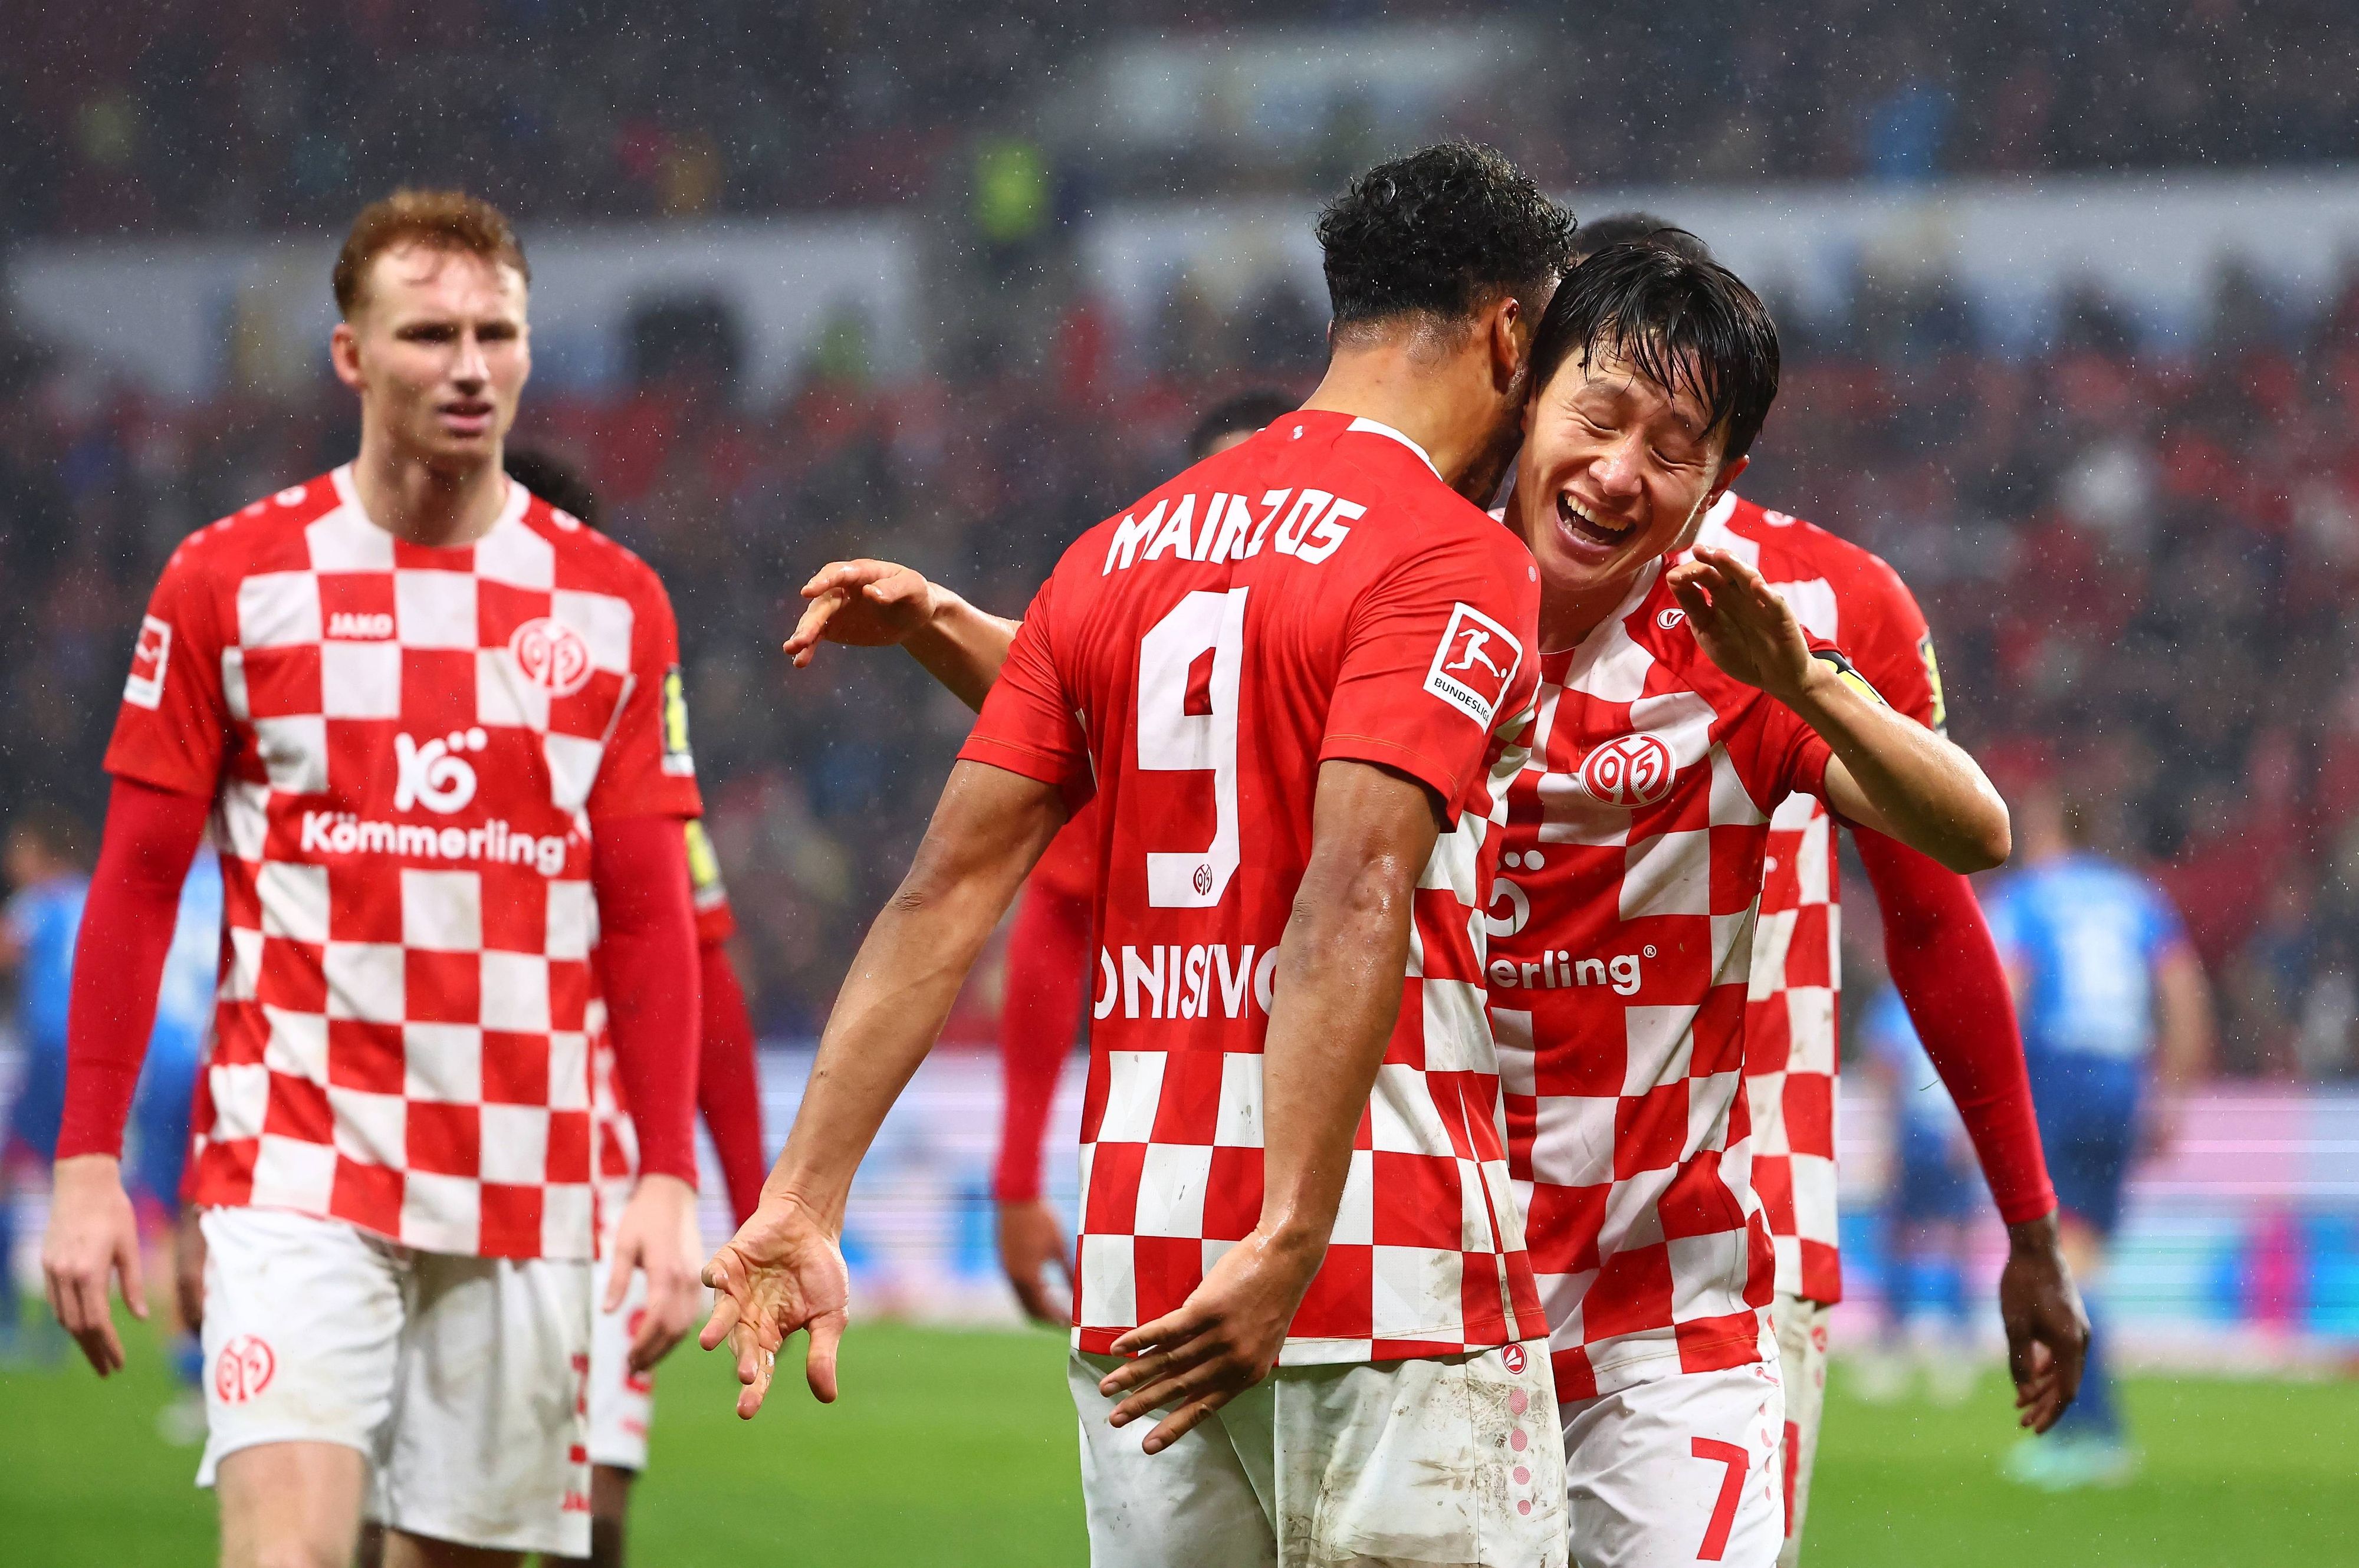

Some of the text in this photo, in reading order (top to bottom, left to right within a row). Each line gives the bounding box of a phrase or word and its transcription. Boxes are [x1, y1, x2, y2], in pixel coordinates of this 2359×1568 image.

[1274, 488, 1368, 565] 05
[328, 612, 395, 638] JAKO
[1434, 677, 1490, 724] BUNDESLIGA
[1138, 586, 1250, 908] 9
[1691, 1436, 1750, 1561] 7
